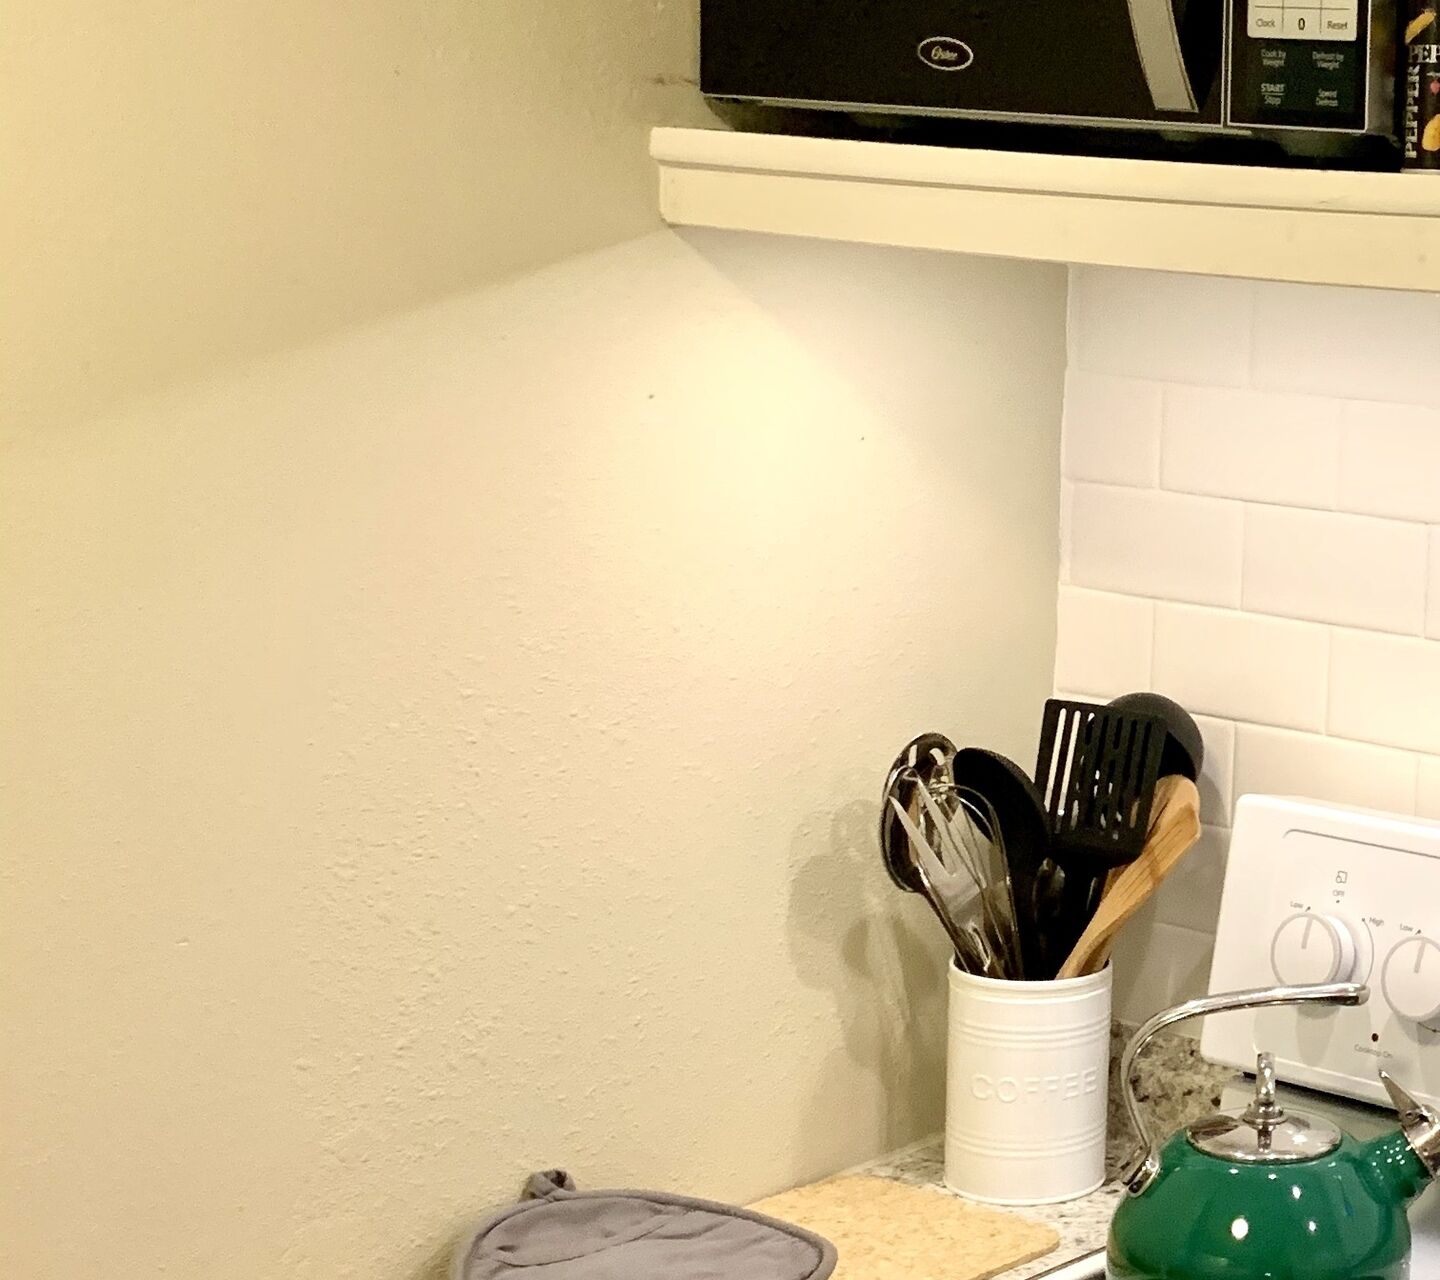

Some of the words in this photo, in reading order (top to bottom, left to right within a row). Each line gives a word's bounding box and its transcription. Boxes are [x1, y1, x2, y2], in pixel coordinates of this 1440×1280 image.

[1298, 18, 1306, 30] 0
[1369, 916, 1384, 927] High
[1400, 924, 1414, 932] Low
[971, 1067, 1098, 1103] COFFEE
